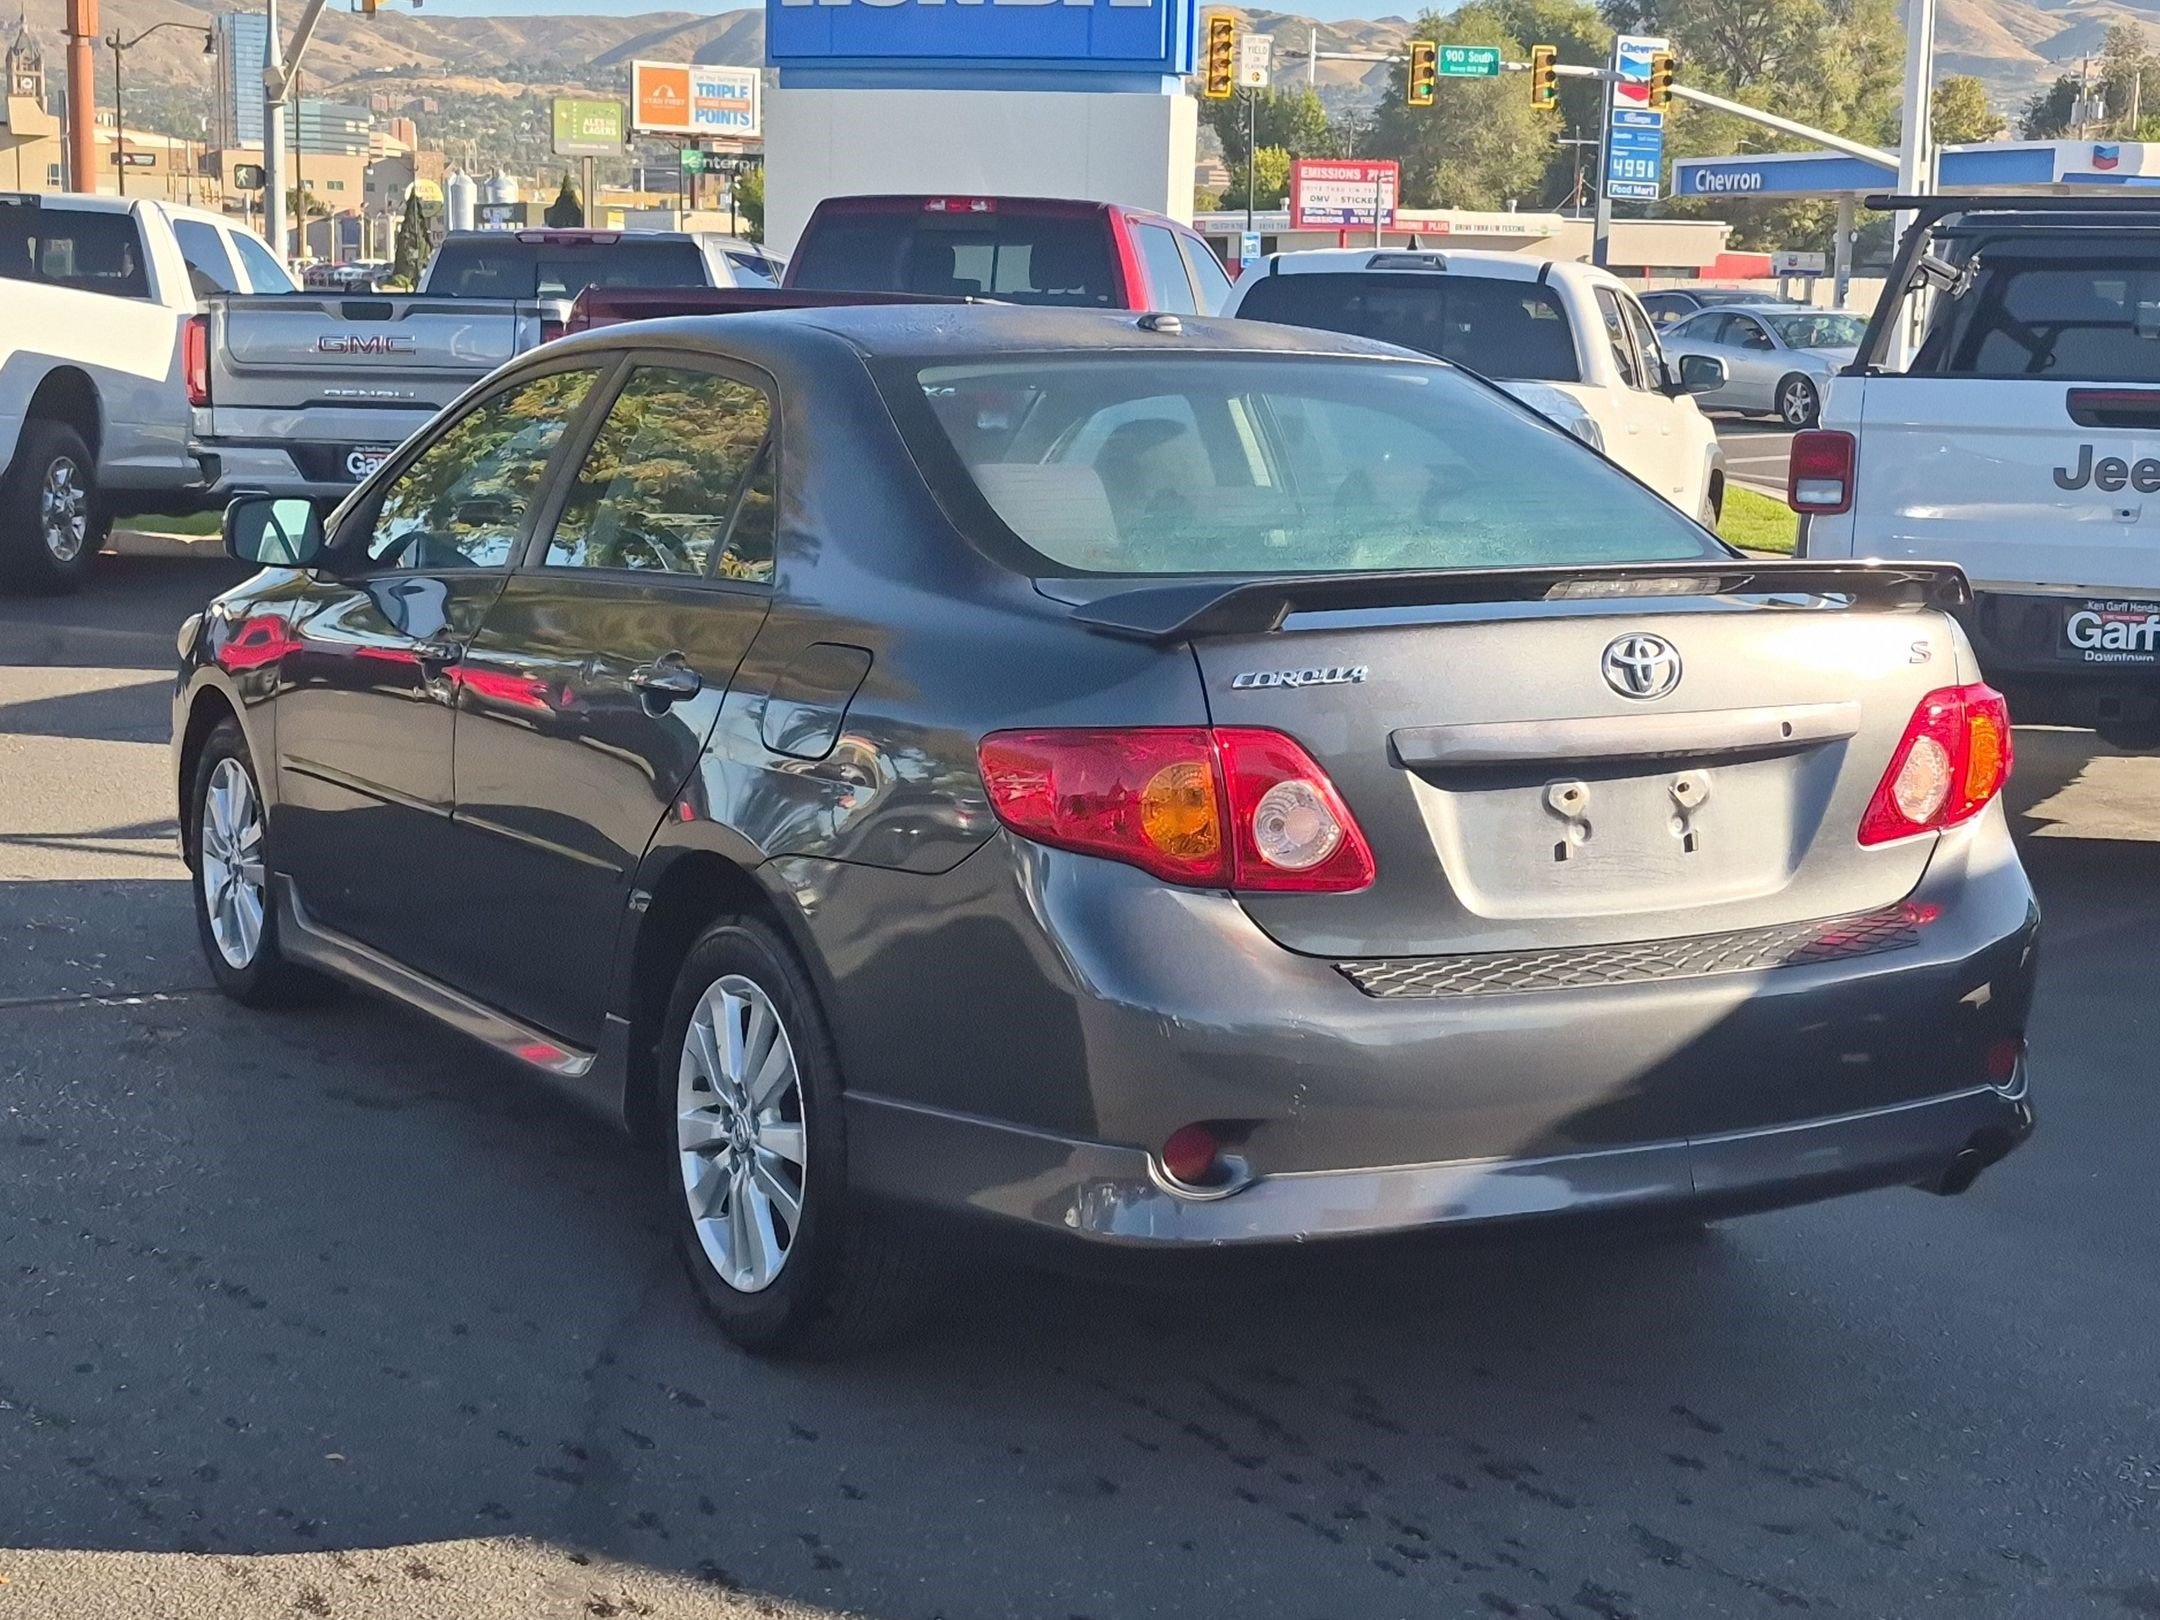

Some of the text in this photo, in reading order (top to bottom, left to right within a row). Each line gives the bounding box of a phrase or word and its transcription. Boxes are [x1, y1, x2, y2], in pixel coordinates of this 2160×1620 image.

[1445, 49, 1493, 63] 900 South
[696, 83, 749, 99] TRIPLE
[695, 110, 750, 127] POINTS
[1301, 166, 1361, 180] EMISSIONS
[1695, 169, 1761, 192] Chevron
[1612, 184, 1654, 196] Food Mart
[1309, 194, 1330, 203] DMV
[317, 335, 416, 355] GMC
[324, 388, 415, 398] DENALI
[2053, 444, 2160, 493] Jee
[2087, 600, 2160, 613] Ken Garff Honda
[1909, 641, 1932, 664] S
[2084, 650, 2154, 662] Downtown
[1232, 665, 1369, 689] COROLLA
